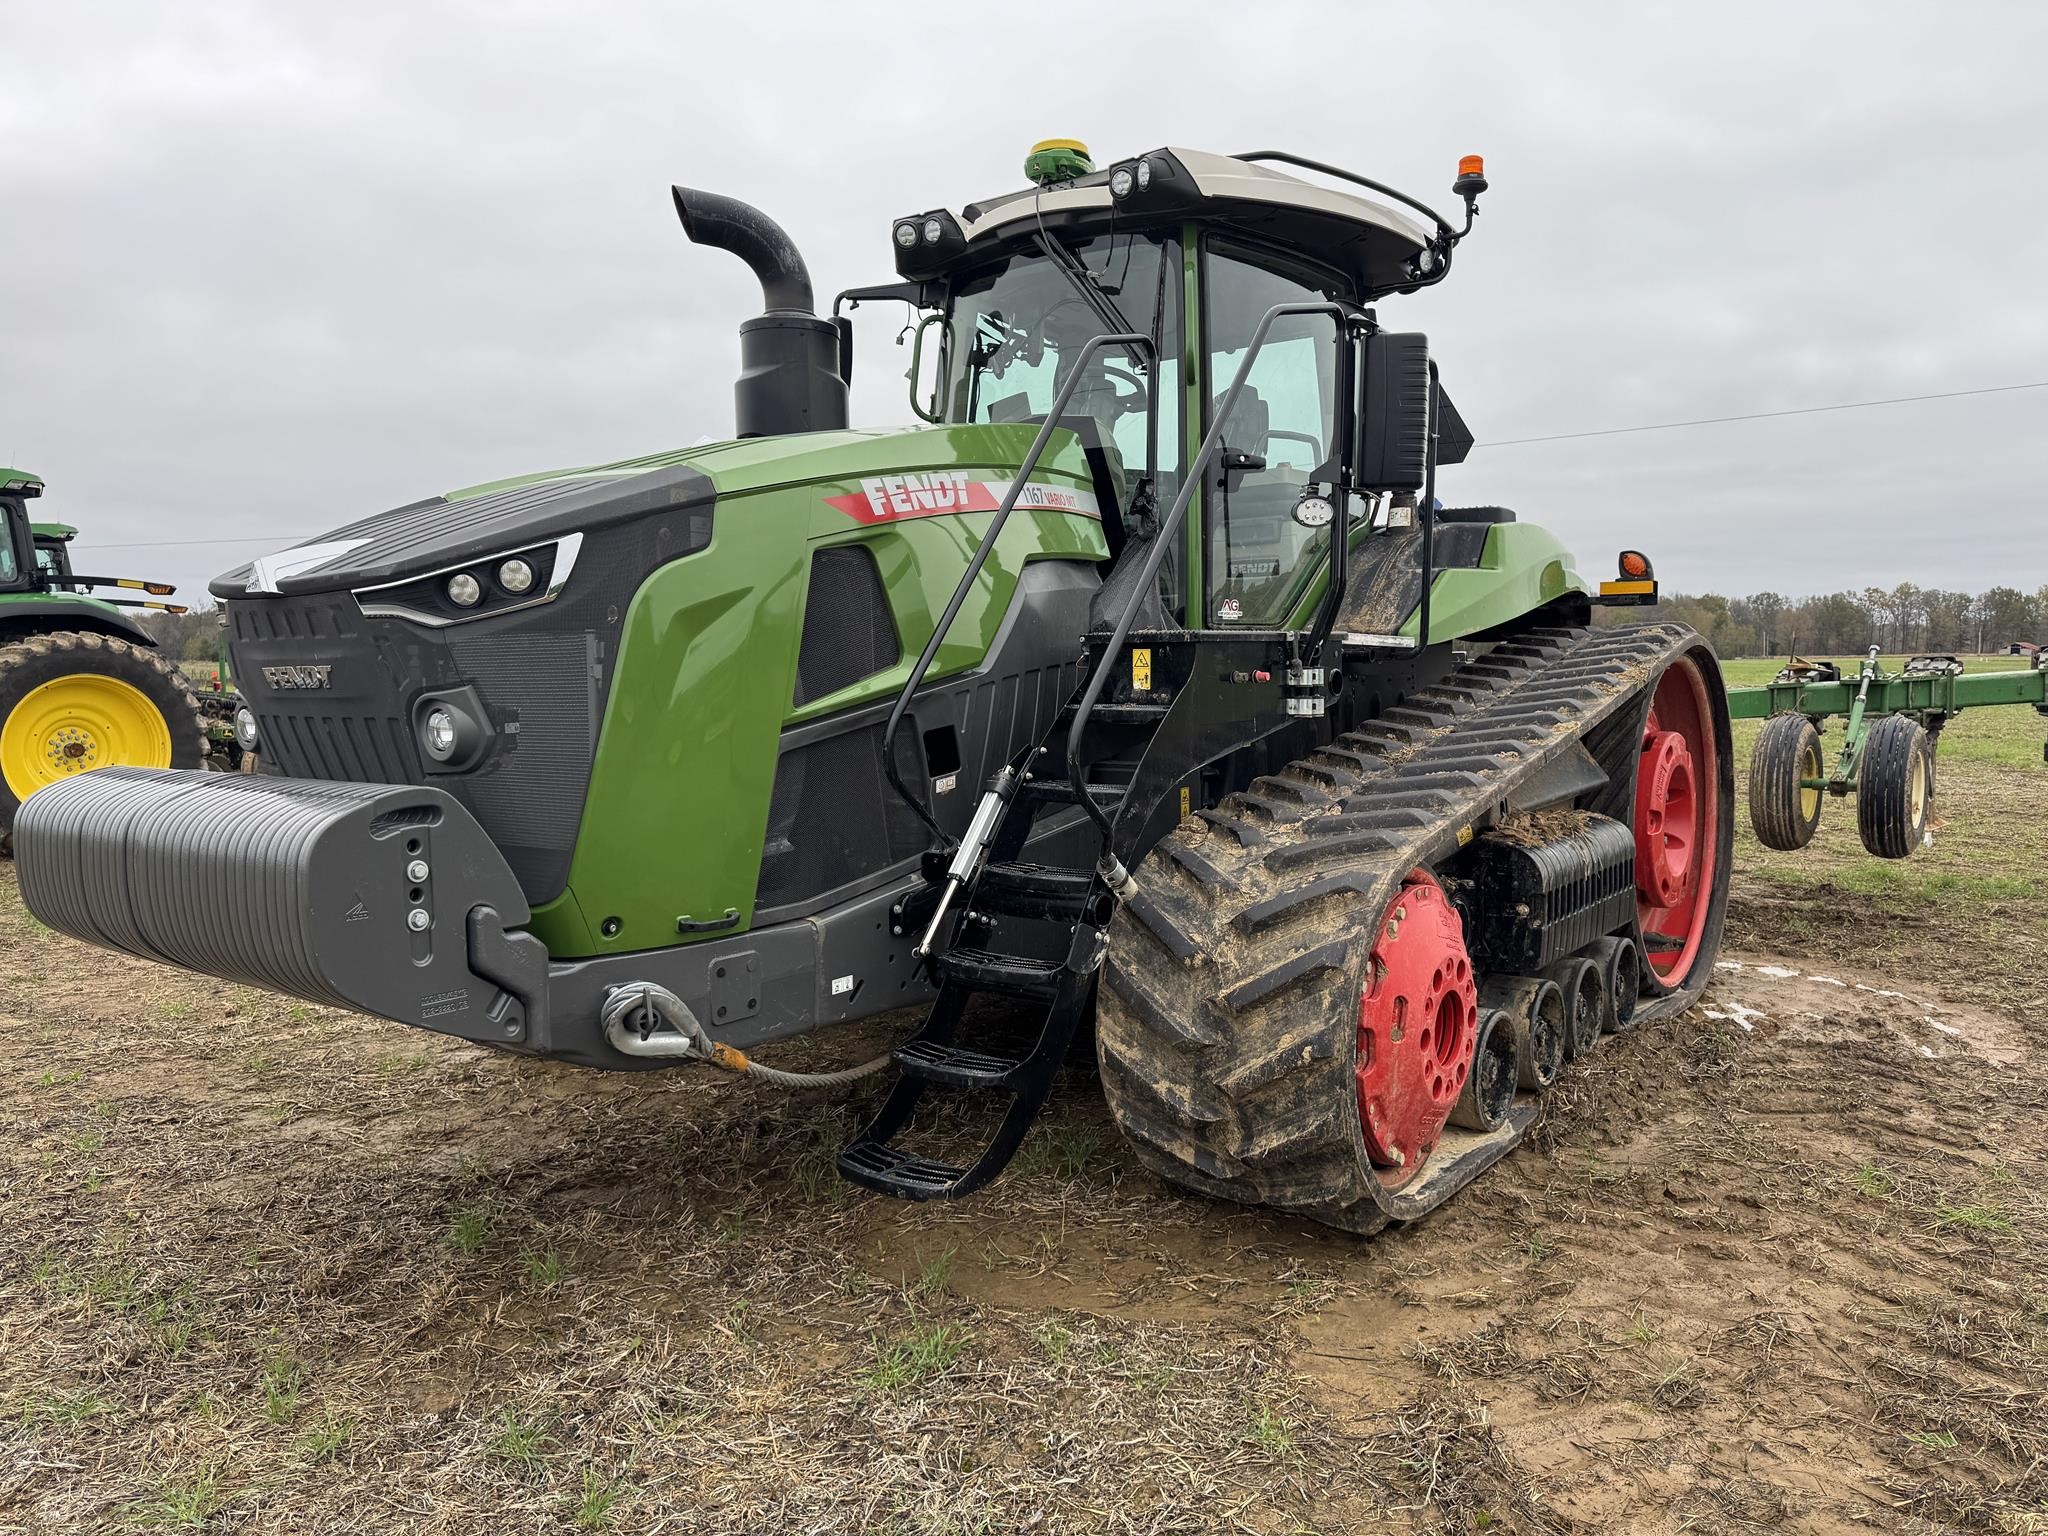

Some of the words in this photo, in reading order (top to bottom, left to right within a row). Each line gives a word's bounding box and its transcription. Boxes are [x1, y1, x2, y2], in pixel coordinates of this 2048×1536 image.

[860, 471, 969, 516] FENDT
[1022, 487, 1044, 505] 1167
[1230, 562, 1278, 574] FENDT
[1222, 600, 1239, 612] AG
[261, 665, 332, 689] FENDT
